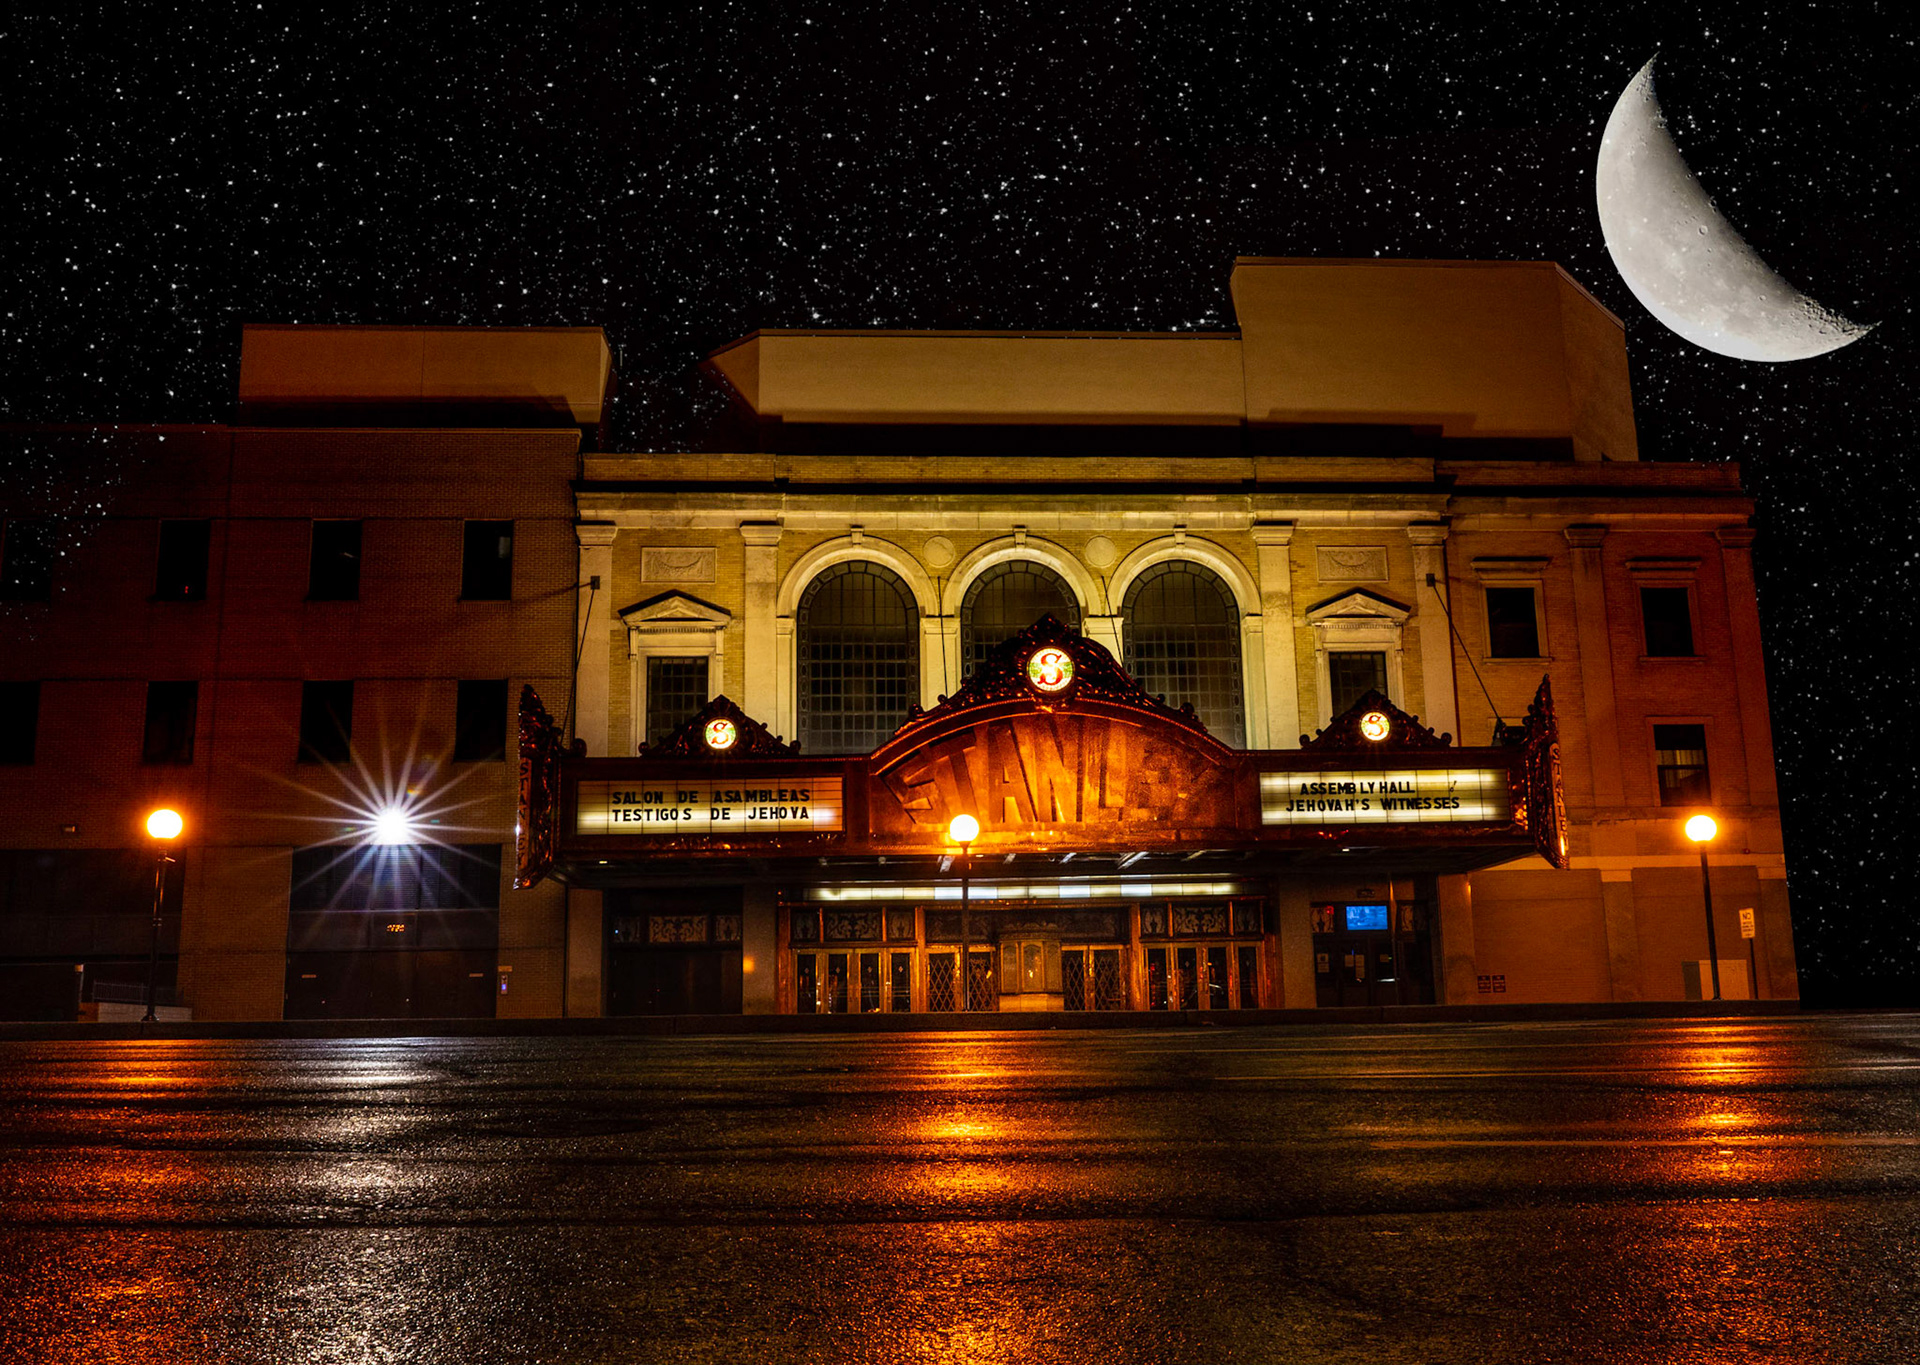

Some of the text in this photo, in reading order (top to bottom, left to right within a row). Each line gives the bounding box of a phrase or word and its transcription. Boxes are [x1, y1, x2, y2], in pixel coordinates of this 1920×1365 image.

[1037, 653, 1064, 686] S
[711, 722, 728, 744] S
[1368, 714, 1385, 737] S
[1299, 780, 1416, 795] ASSEMBLY HALL
[612, 789, 810, 805] SALON DE ASAMBLEAS
[1286, 797, 1460, 812] JEHOVAH'S WITNESSES
[612, 806, 809, 822] TESTIGOS DE JEHOVA
